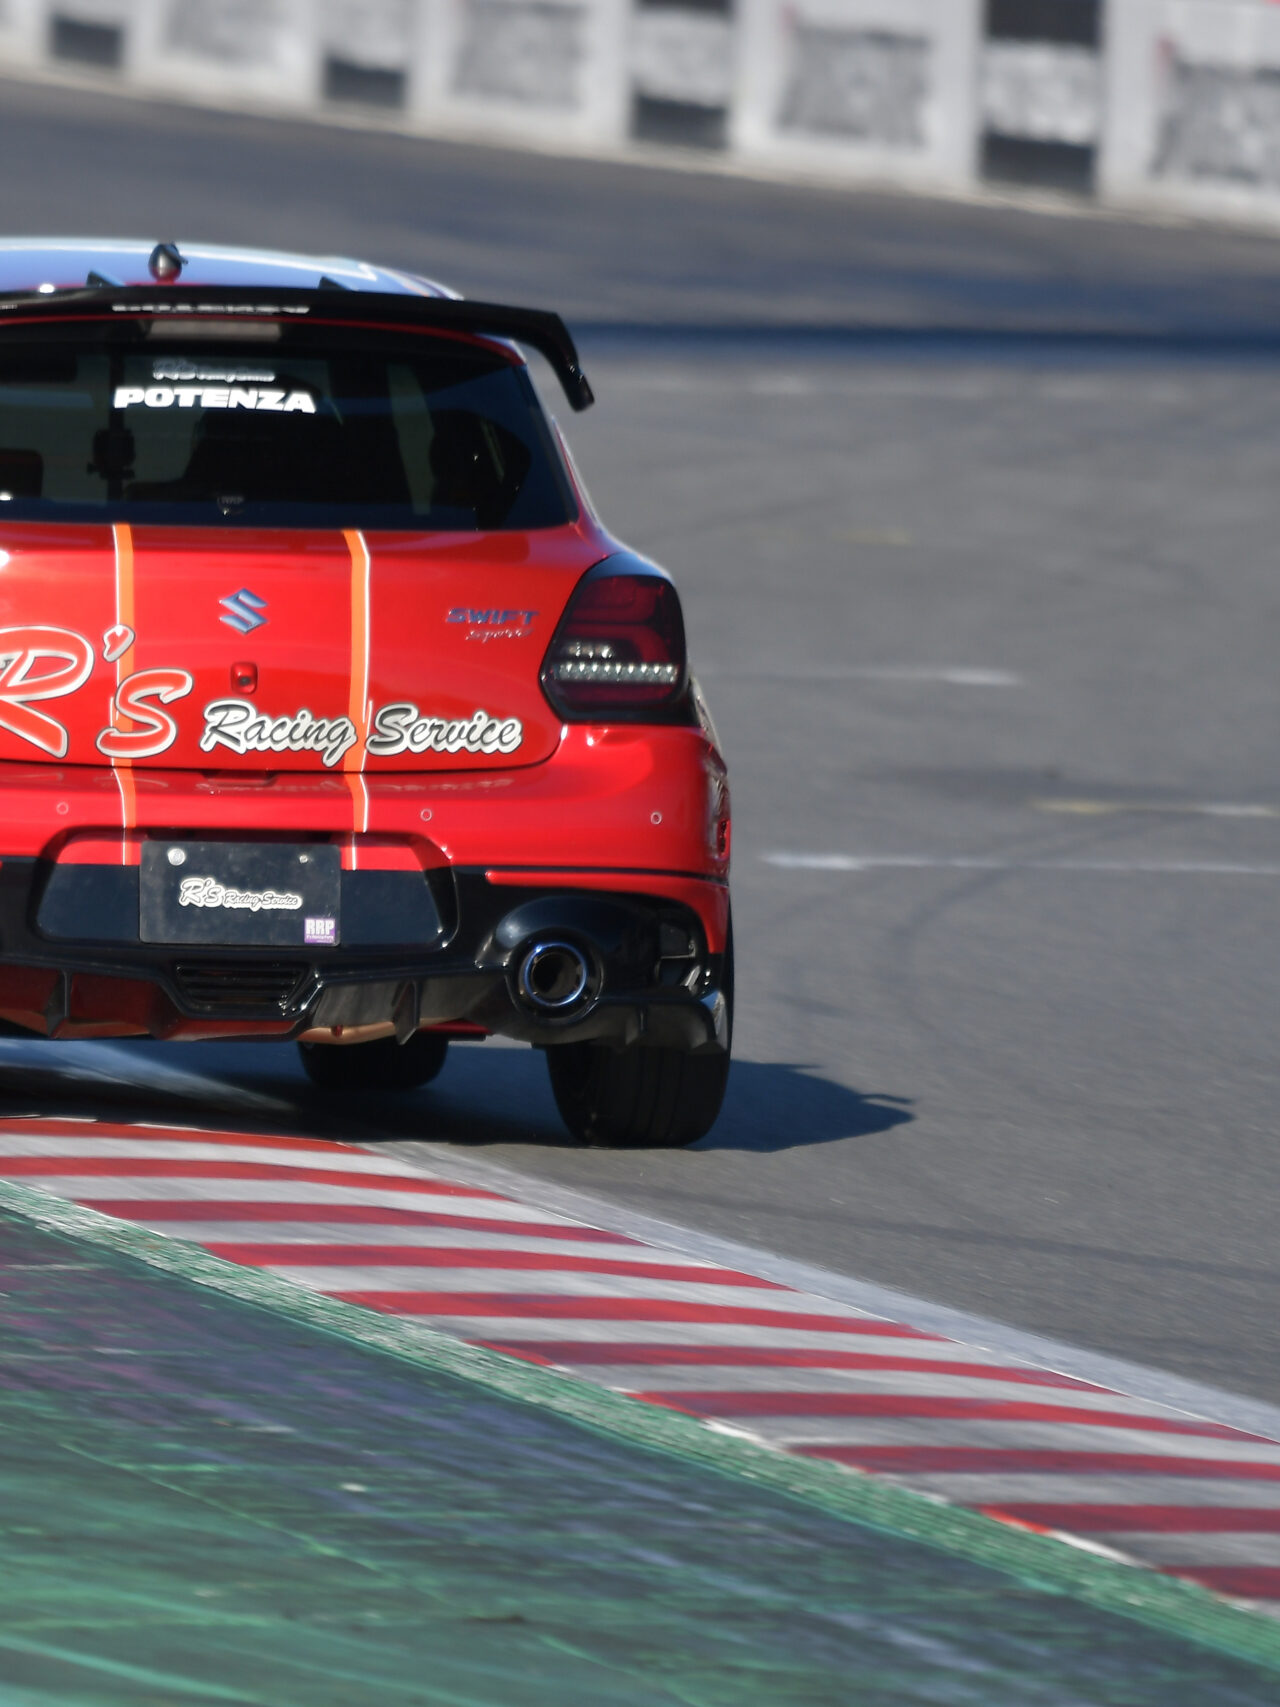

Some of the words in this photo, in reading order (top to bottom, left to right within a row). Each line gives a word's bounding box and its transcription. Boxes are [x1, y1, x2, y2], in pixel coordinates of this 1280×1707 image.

[113, 386, 317, 414] POTENZA
[445, 606, 540, 625] SWIFT
[199, 698, 358, 768] Racing
[365, 702, 523, 757] Service
[223, 889, 261, 912] Racing
[260, 889, 303, 910] Service
[305, 918, 335, 936] RRP
